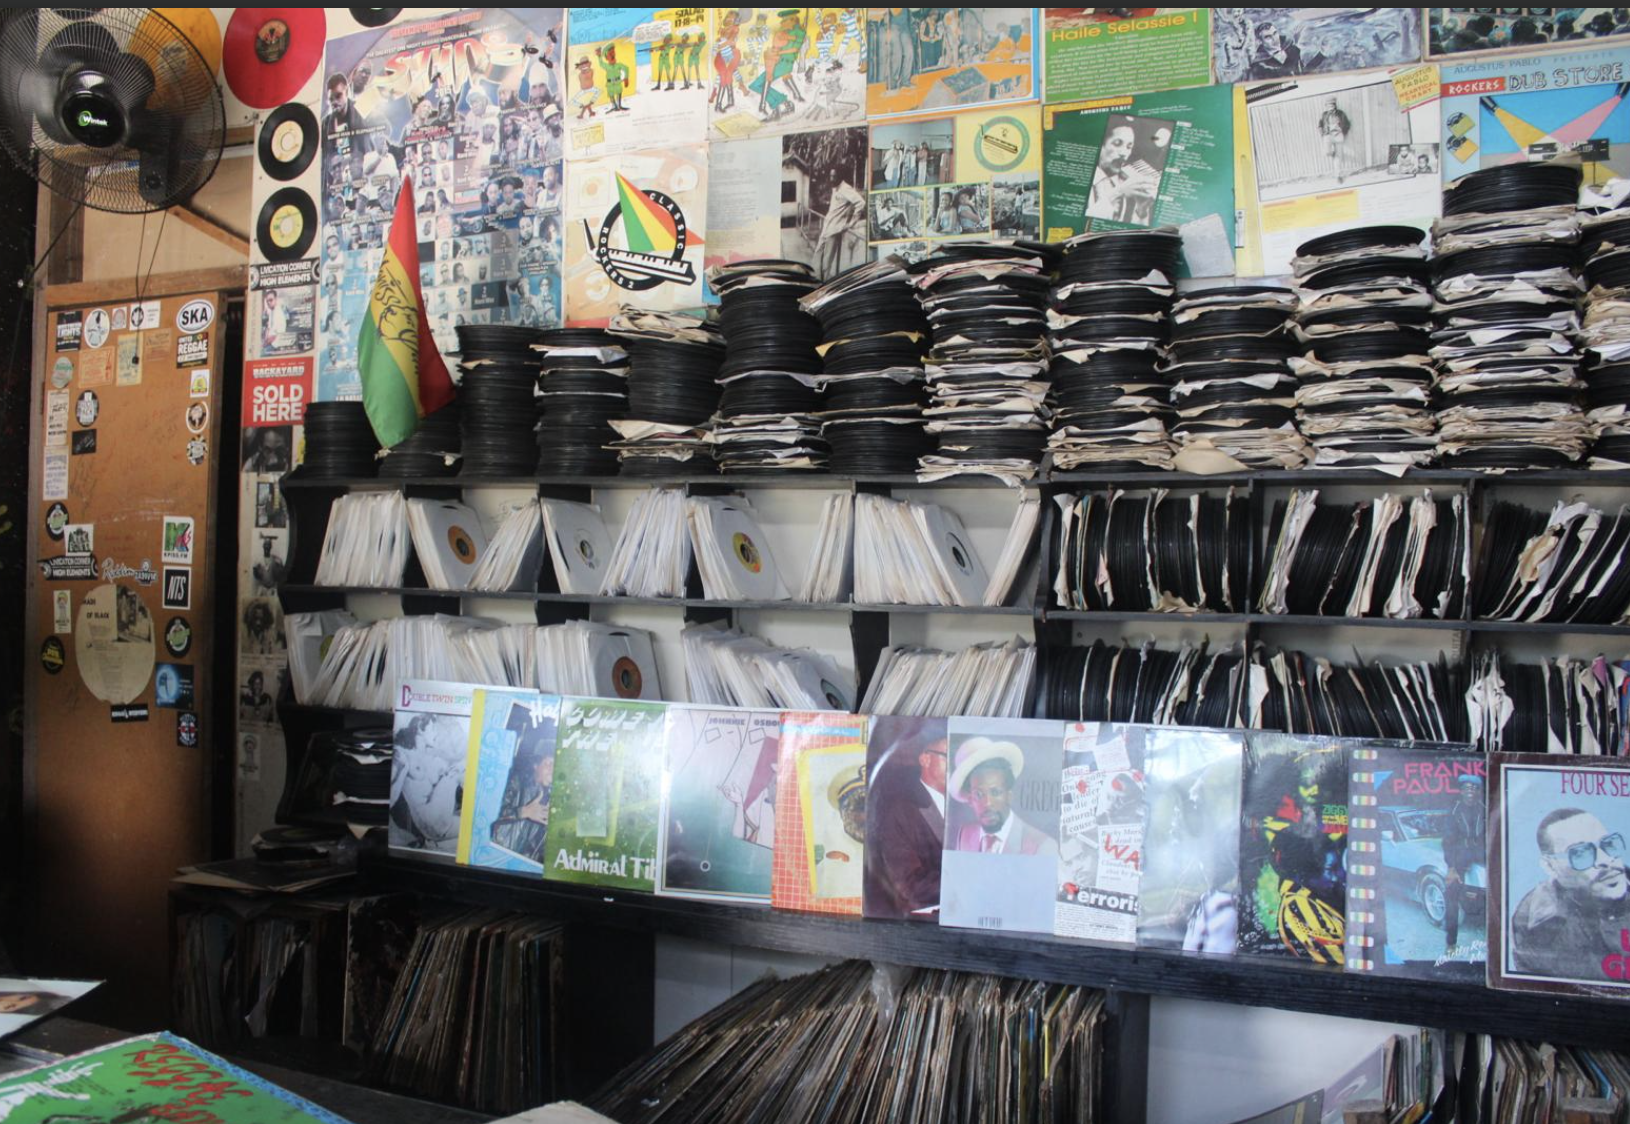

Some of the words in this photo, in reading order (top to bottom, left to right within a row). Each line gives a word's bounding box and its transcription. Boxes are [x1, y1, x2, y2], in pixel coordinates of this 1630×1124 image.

[1051, 27, 1101, 43] Haile
[1107, 14, 1187, 35] Selassie
[1449, 80, 1500, 96] ROCKERS
[1508, 71, 1547, 92] DUB
[1552, 61, 1624, 88] STORE
[182, 307, 208, 325] SKA
[177, 339, 208, 354] REGGAE
[253, 384, 304, 404] SOLD
[253, 402, 302, 422] HERE
[167, 576, 186, 600] NTS
[1404, 760, 1487, 779] FRANK
[1393, 777, 1460, 795] PAUL
[1561, 769, 1605, 796] FOUR
